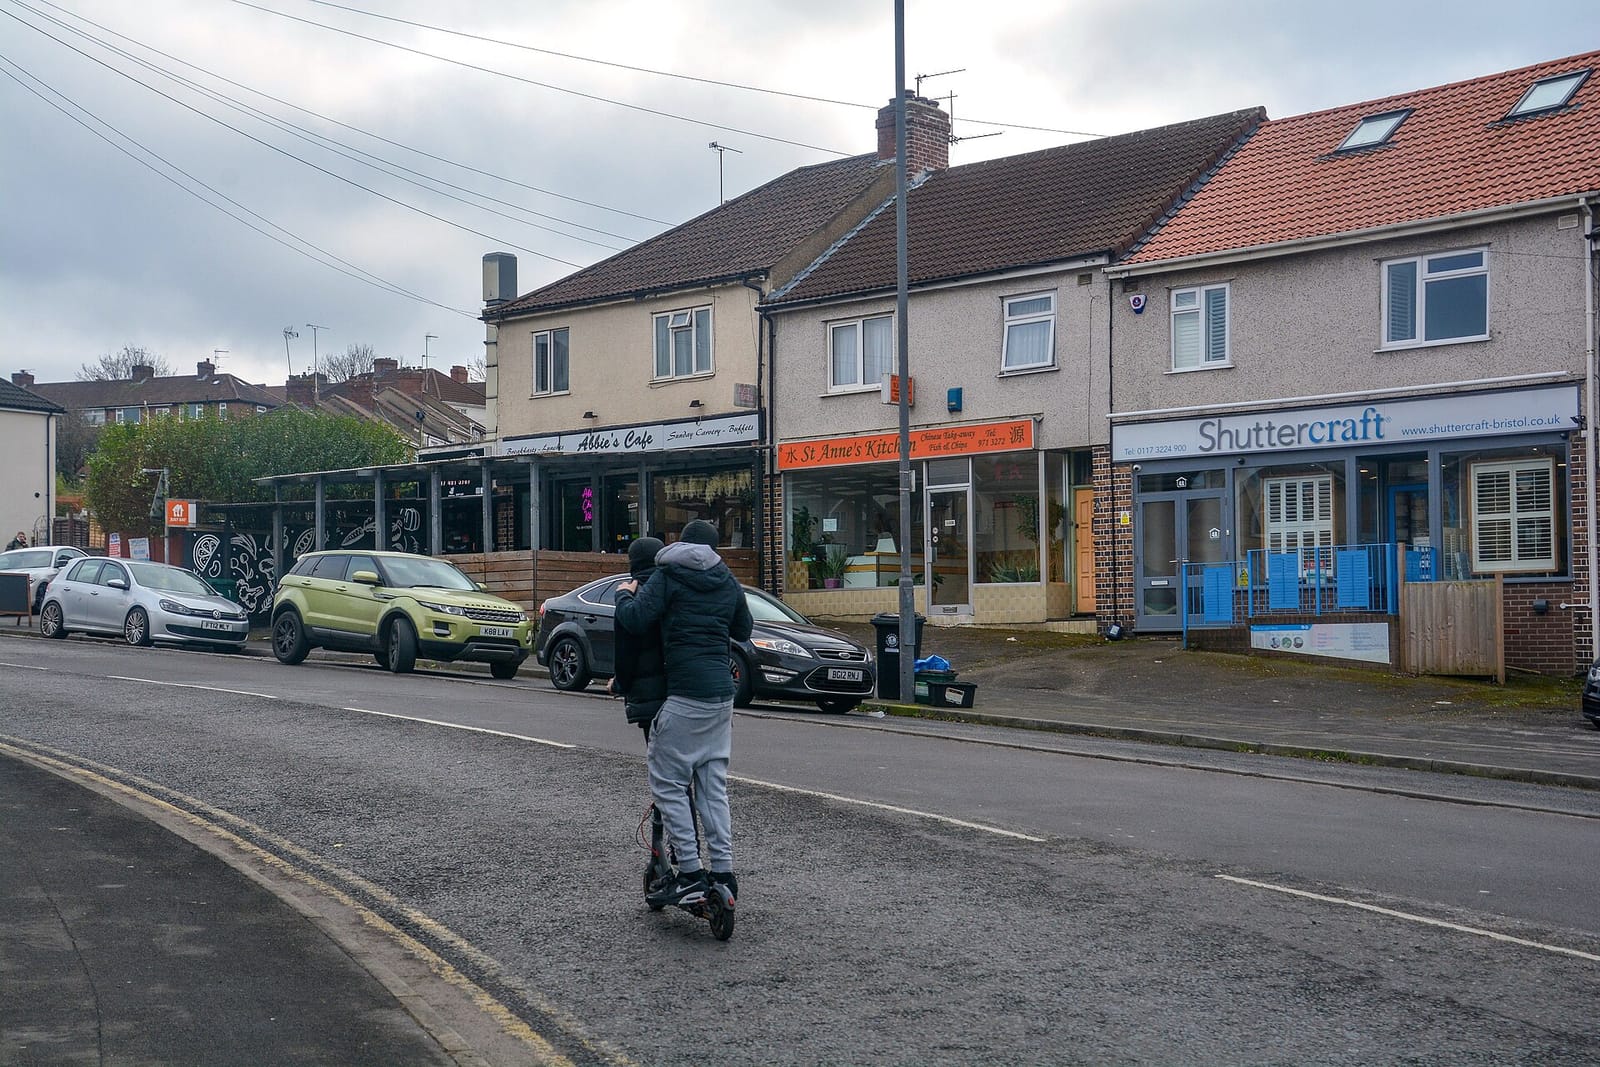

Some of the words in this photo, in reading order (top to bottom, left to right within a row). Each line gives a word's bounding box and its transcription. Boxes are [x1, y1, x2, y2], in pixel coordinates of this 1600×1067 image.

[666, 430, 694, 441] Sunday
[695, 428, 722, 437] Carvery
[728, 423, 754, 435] Buffets
[1009, 424, 1025, 444] 源
[1401, 414, 1561, 436] www.shuttercraft-bristol.co.uk
[576, 431, 620, 452] Abbie's
[624, 429, 654, 450] Cafe
[920, 432, 942, 442] Chinese
[943, 430, 976, 441] Take-away
[800, 444, 816, 463] St
[816, 442, 862, 463] Anne's
[864, 433, 917, 459] Kitchn
[928, 443, 942, 452] Fish
[950, 441, 968, 452] Chips
[1136, 446, 1154, 455] 0117
[1154, 445, 1173, 454] 3224
[1173, 444, 1187, 452] 900
[832, 670, 846, 679] BG12
[847, 671, 860, 680] RNJ
